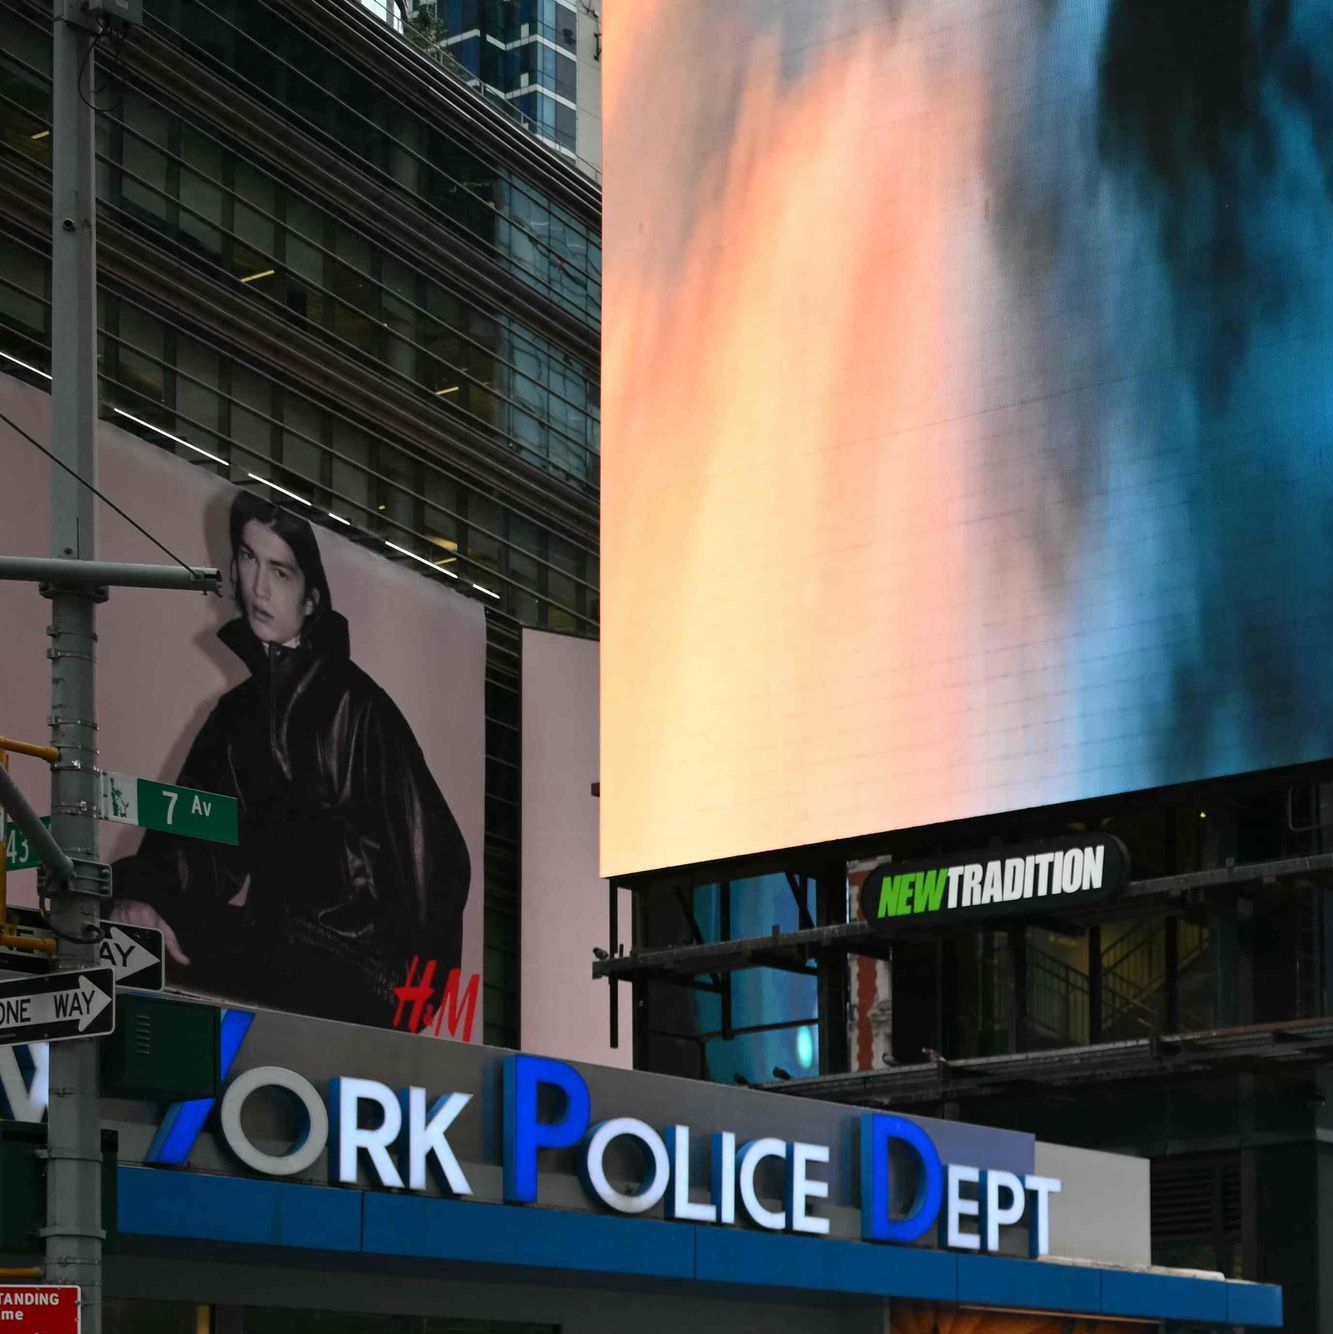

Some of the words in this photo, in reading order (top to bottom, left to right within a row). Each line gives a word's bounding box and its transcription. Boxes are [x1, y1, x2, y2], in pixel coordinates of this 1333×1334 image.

[162, 790, 178, 825] 7
[191, 796, 212, 817] Av
[100, 941, 136, 968] AY
[54, 990, 96, 1018] WAY
[392, 955, 480, 1044] H&M
[503, 1052, 830, 1234] POLICE
[861, 1111, 1062, 1258] DEPT
